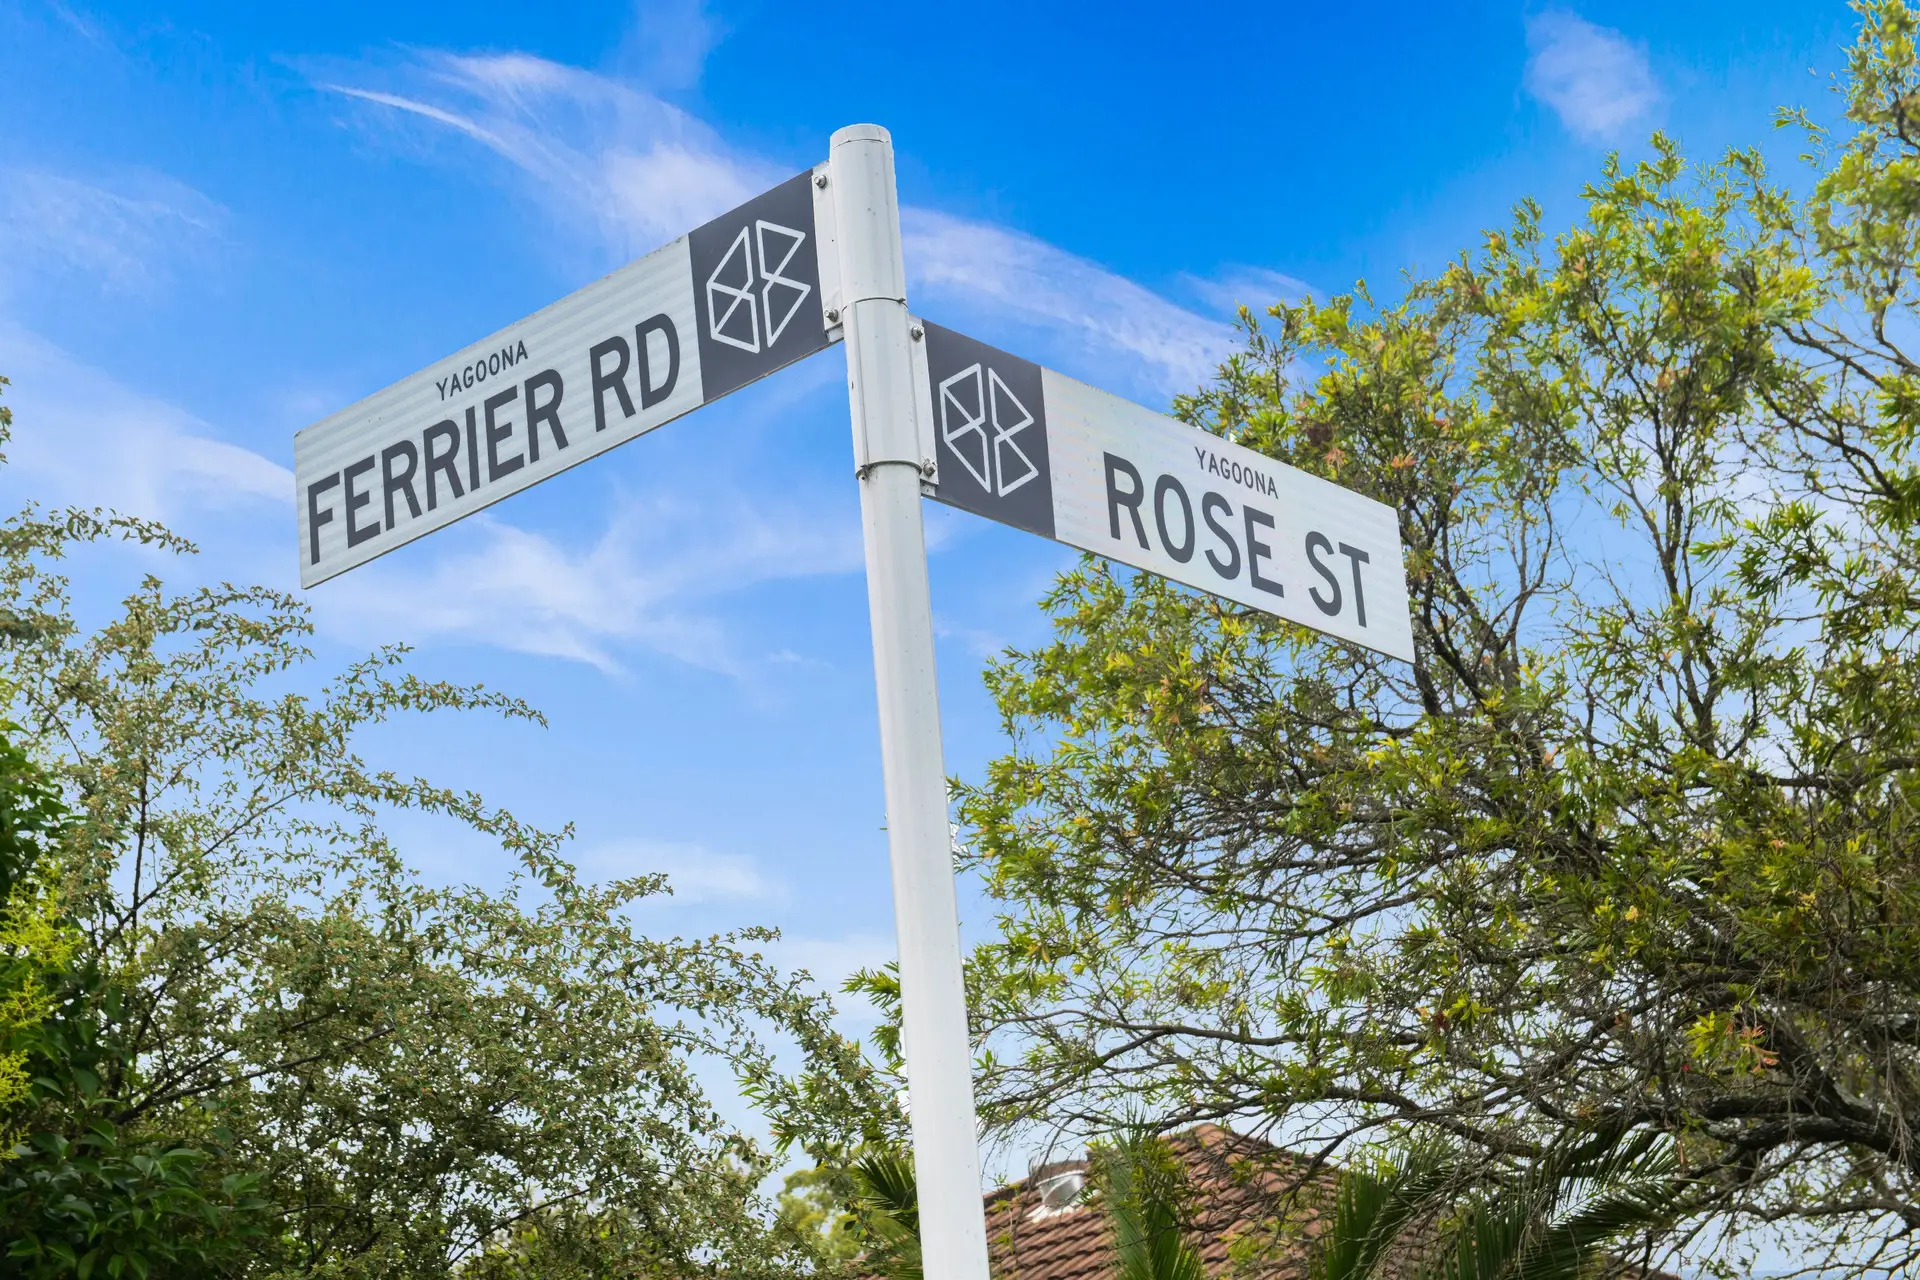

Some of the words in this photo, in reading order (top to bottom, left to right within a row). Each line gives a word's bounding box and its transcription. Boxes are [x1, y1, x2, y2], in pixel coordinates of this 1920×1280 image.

[436, 340, 528, 401] YAGOONA
[307, 369, 569, 565] FERRIER
[589, 313, 681, 432] RD
[1194, 446, 1279, 500] YAGOONA
[1103, 451, 1285, 598] ROSE
[1304, 531, 1370, 628] ST
